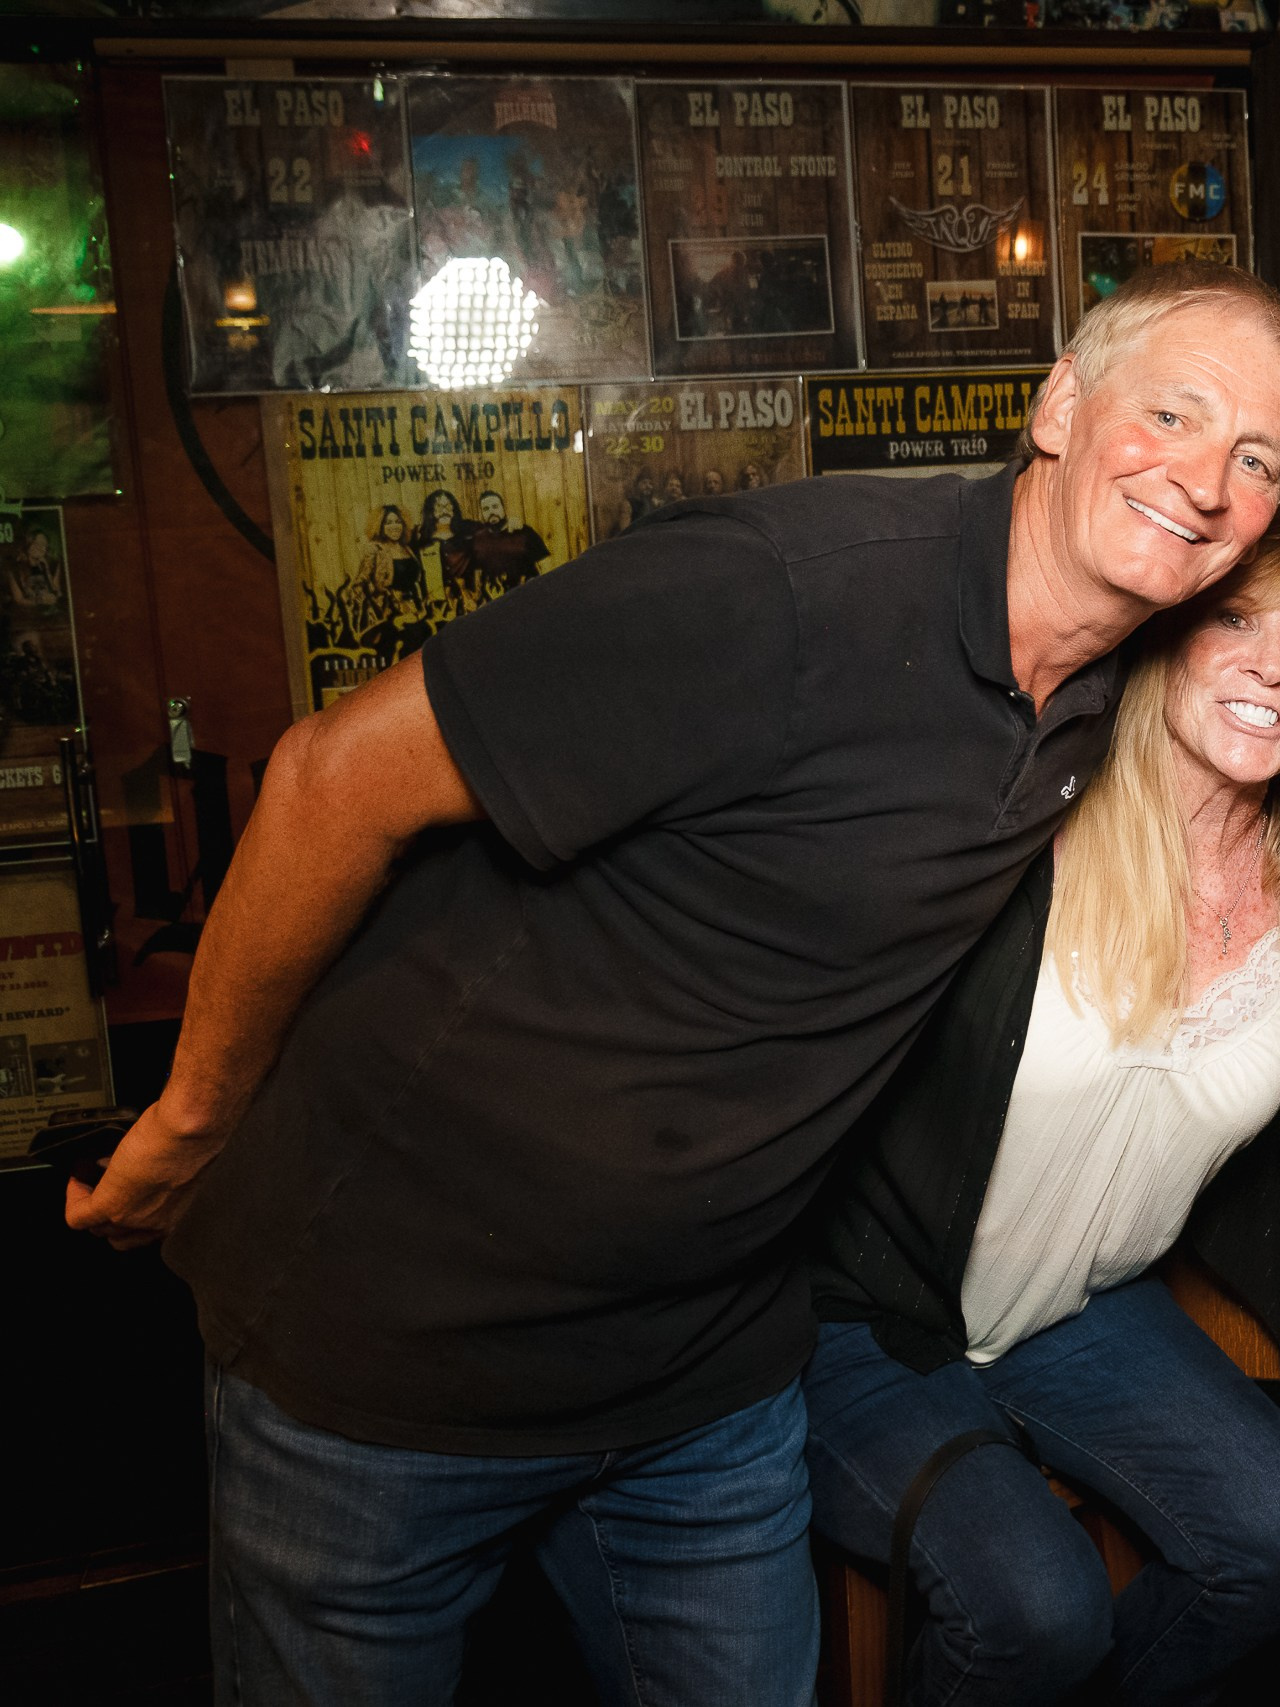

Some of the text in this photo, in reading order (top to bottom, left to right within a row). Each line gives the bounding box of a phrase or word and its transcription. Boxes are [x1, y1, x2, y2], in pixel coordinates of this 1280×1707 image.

[224, 89, 345, 127] EL PASO
[687, 91, 794, 127] EL PASO
[900, 95, 1000, 130] EL PASO
[1102, 95, 1201, 132] EL PASO
[267, 157, 313, 203] 22
[715, 155, 838, 177] CONTROL STONE
[937, 154, 972, 196] 21
[1072, 160, 1109, 206] 24
[1174, 182, 1221, 200] FMC
[864, 262, 923, 280] CONCIERTO
[1016, 281, 1030, 298] IN
[1007, 302, 1040, 319] SPAIN
[649, 396, 674, 414] 20
[679, 388, 793, 430] EL PASO
[818, 382, 1032, 437] SANTI CAMPILL
[299, 399, 571, 460] SANTI CAMPILLO
[889, 438, 945, 460] POWER
[382, 463, 447, 484] POWER
